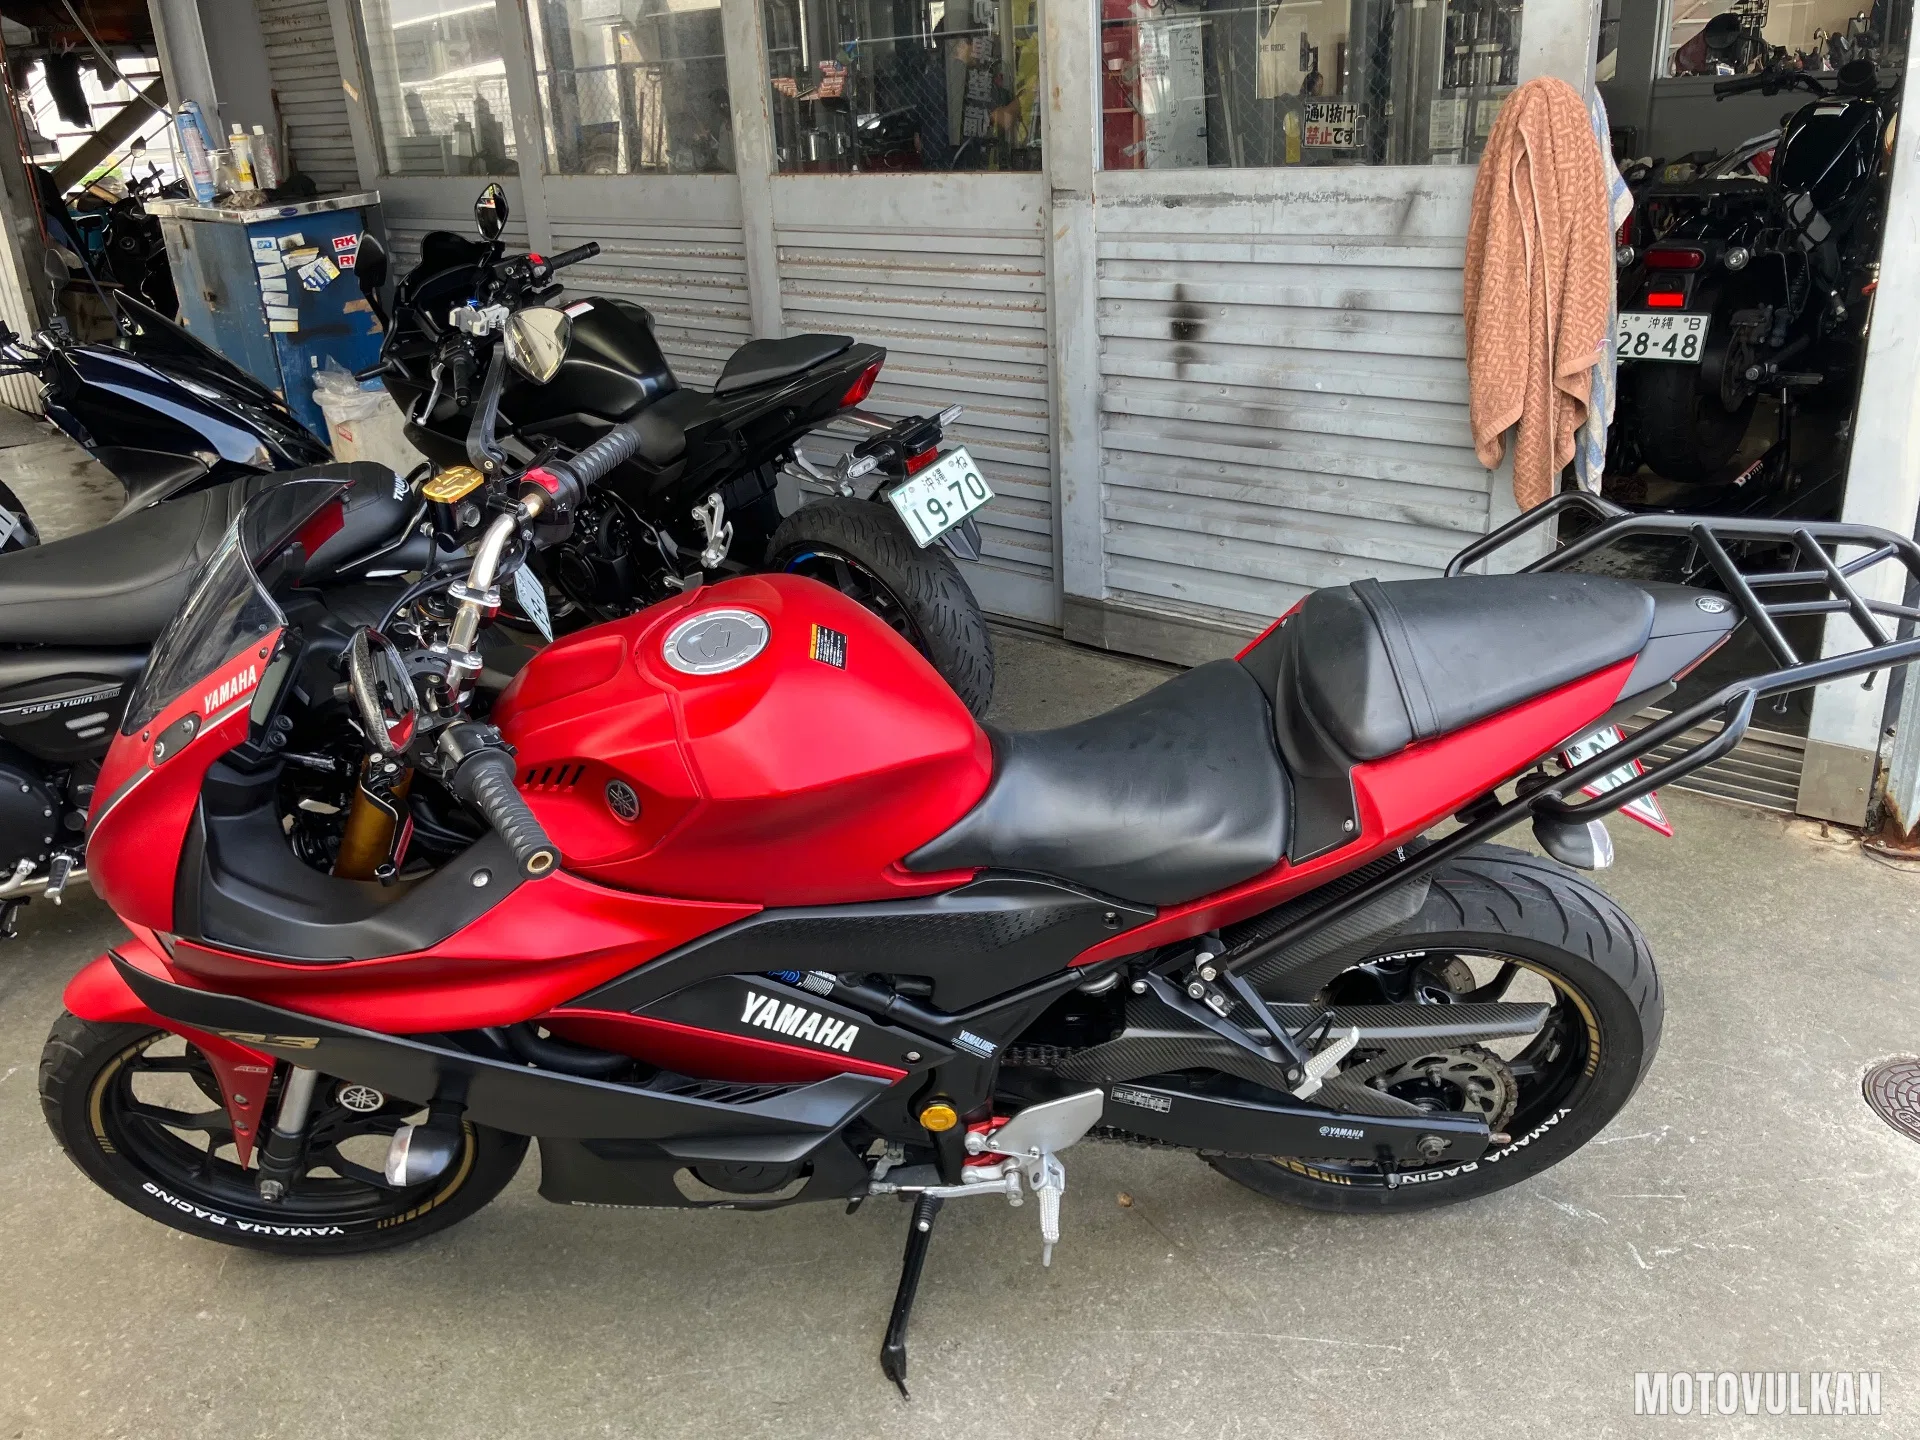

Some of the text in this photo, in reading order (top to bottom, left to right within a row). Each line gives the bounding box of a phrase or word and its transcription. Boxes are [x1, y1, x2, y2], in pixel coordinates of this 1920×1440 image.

[1306, 103, 1355, 123] 通り抜け
[1306, 126, 1354, 145] 禁止です
[334, 236, 356, 249] RK
[1648, 316, 1673, 329] 沖縄
[1688, 317, 1701, 330] B
[1617, 331, 1698, 358] 28-48
[921, 468, 947, 493] 沖縄
[913, 472, 986, 537] 19-70
[204, 664, 257, 715] YAMAHA
[21, 696, 93, 715] SPEED TWIN
[741, 991, 860, 1052] YAMAHA
[959, 1030, 998, 1053] YAMALUBE
[1330, 1127, 1364, 1138] YAMAHA
[1402, 1108, 1572, 1184] YAMAHA RACIN
[142, 1182, 345, 1236] YAMAHA RACING
